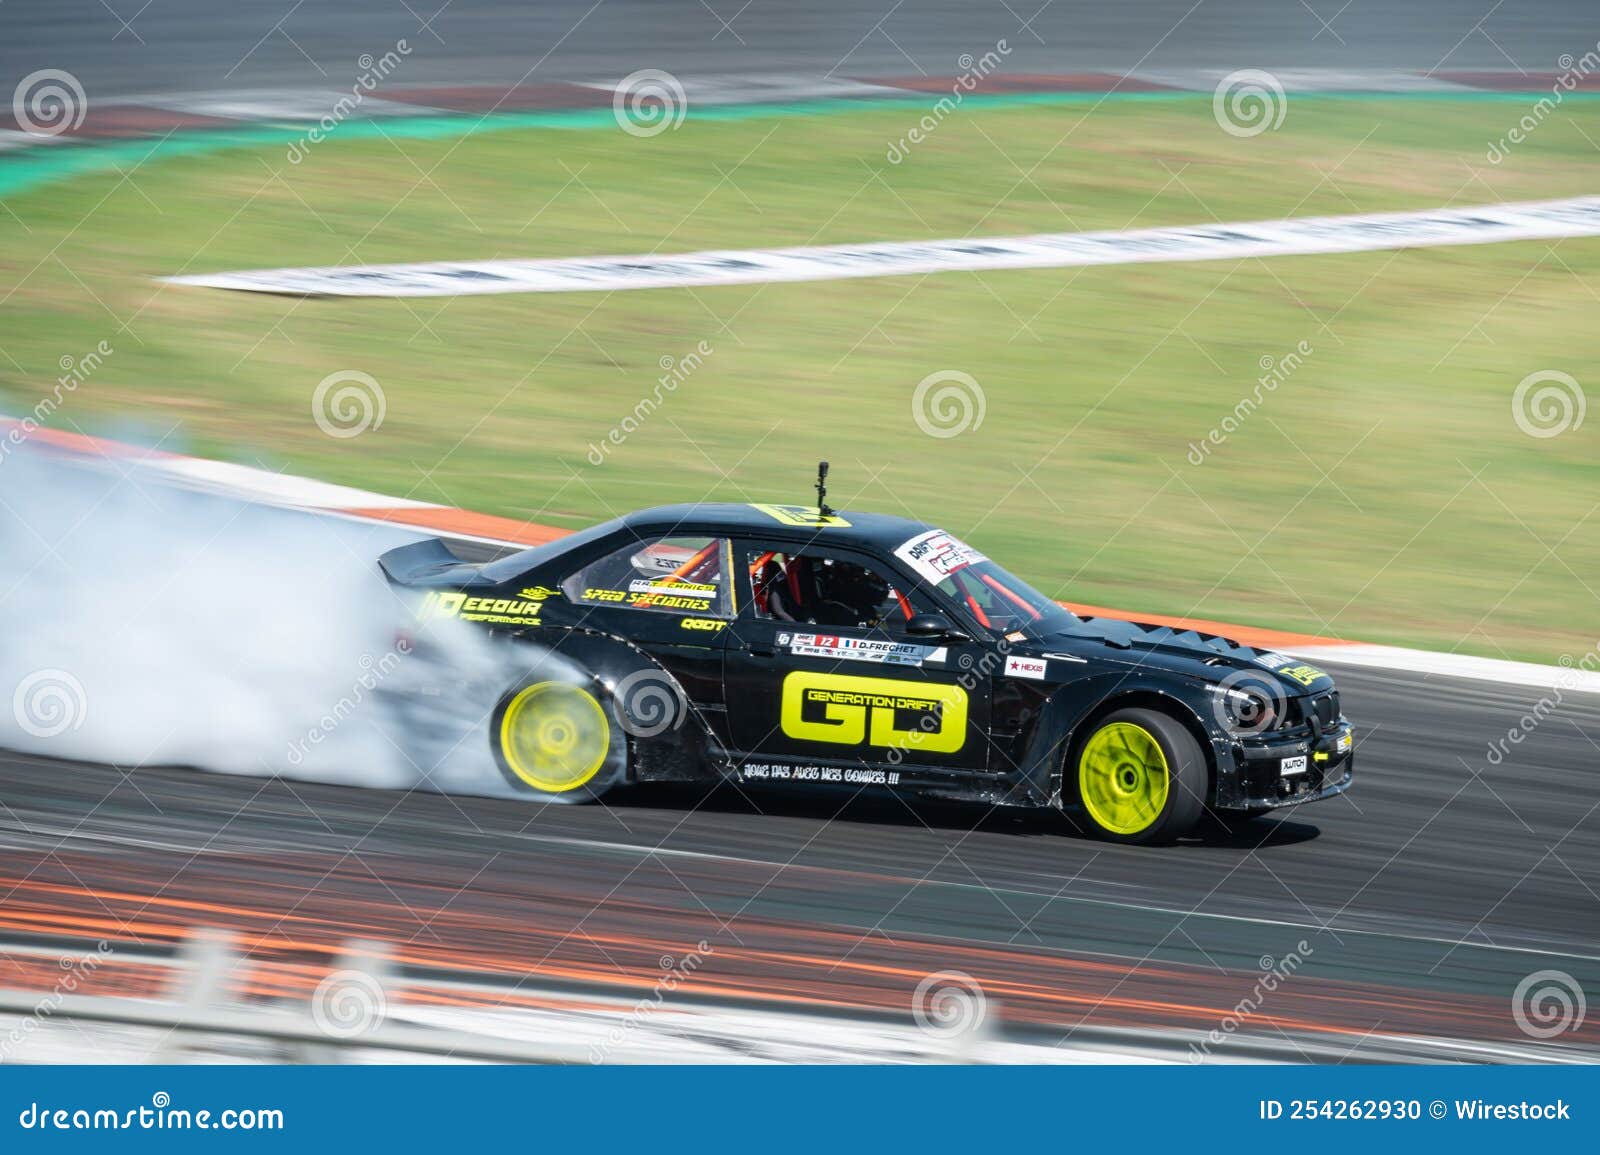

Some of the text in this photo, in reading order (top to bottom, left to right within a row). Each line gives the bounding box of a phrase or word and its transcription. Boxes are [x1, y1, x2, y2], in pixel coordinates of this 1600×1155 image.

[581, 588, 627, 602] SPEED
[859, 642, 917, 654] D.FRECHET
[1021, 663, 1043, 673] HEXIS
[807, 690, 937, 712] GENERATION DRIFT
